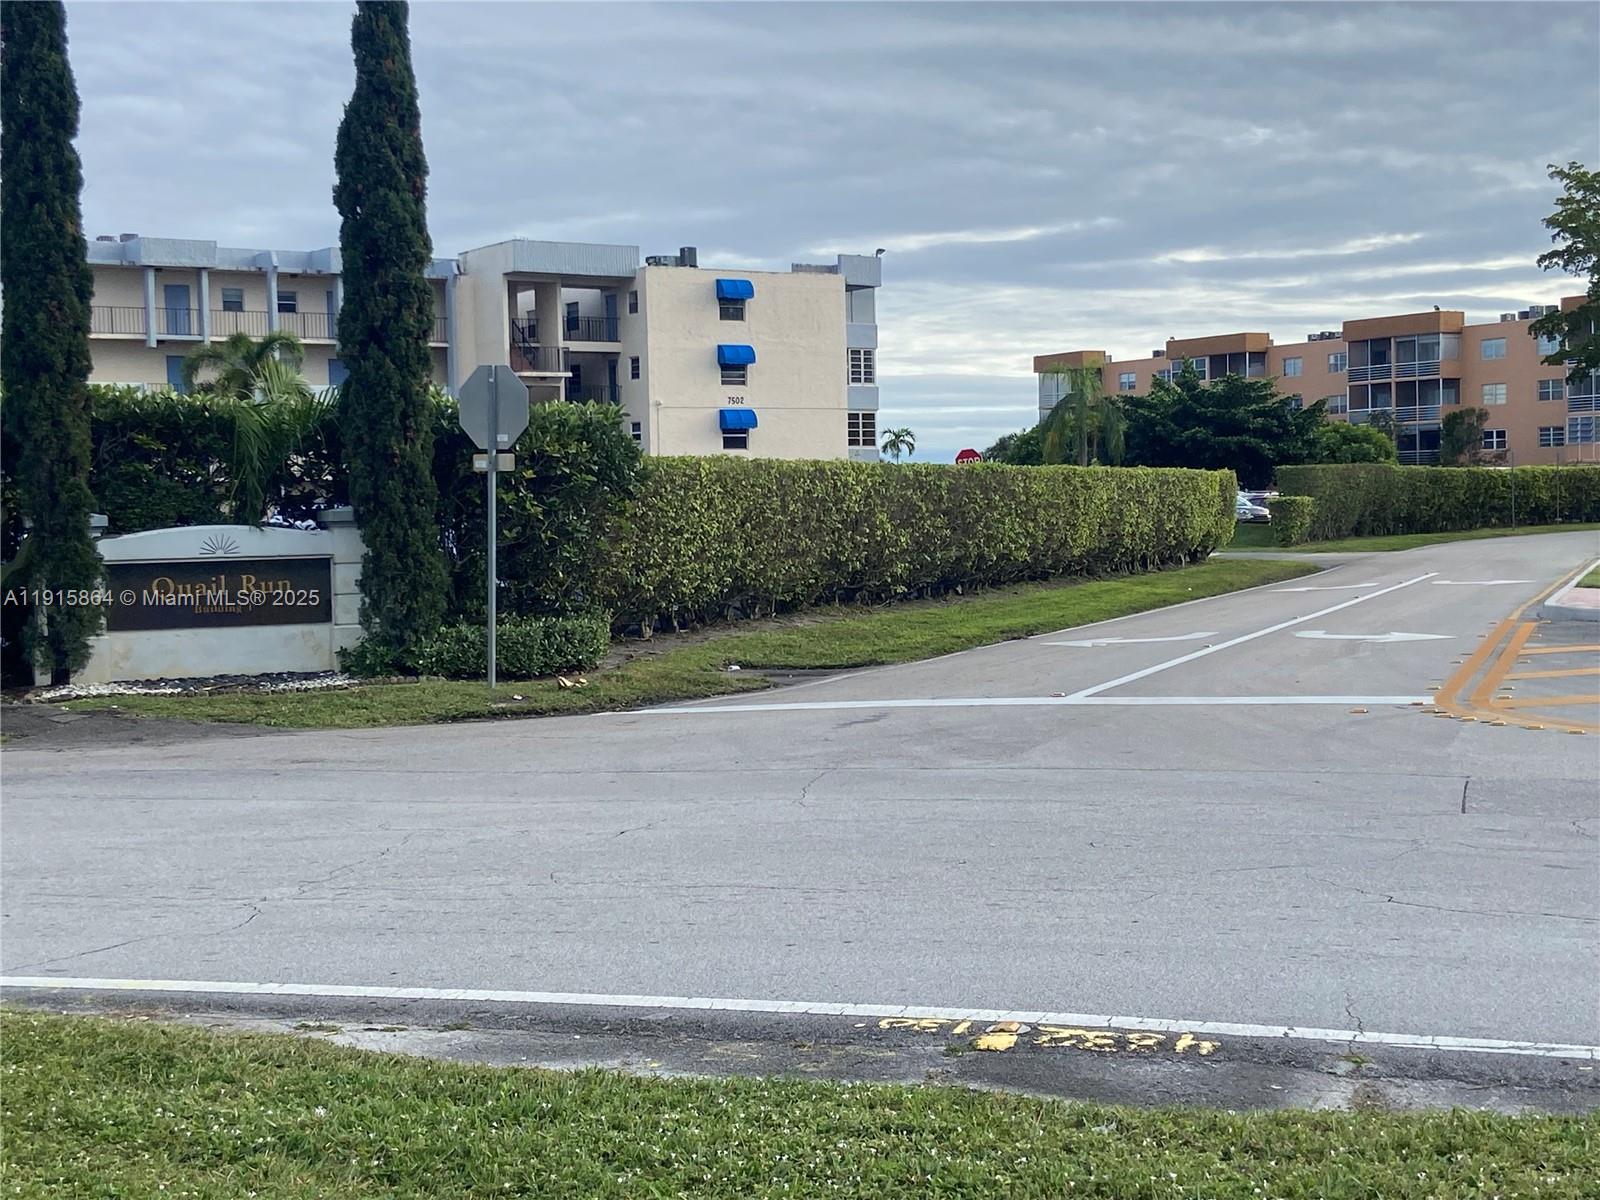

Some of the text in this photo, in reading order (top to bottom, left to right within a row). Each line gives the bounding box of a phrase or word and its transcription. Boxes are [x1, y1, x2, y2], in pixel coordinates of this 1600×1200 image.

[728, 396, 744, 405] 7502
[152, 574, 291, 597] Quail Run
